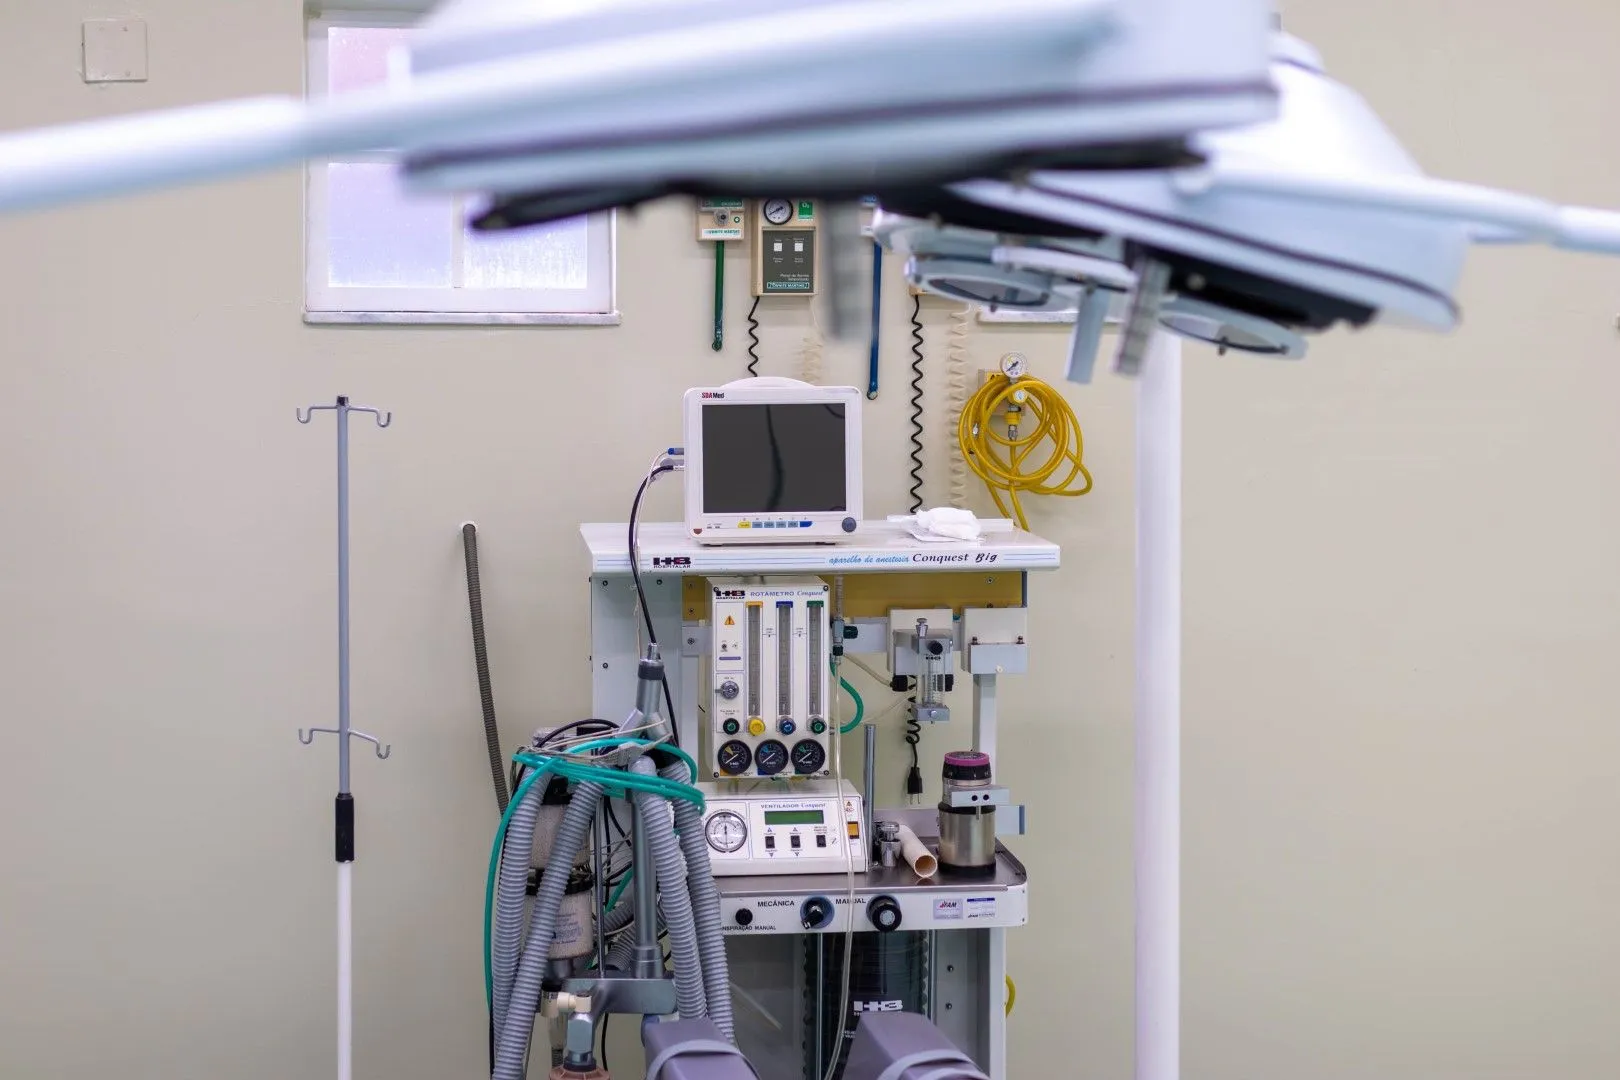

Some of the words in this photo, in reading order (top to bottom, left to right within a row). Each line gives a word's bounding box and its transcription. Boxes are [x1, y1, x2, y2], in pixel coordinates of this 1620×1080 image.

[829, 555, 862, 565] aparelho
[864, 555, 874, 563] de
[912, 553, 969, 564] Conquest
[975, 552, 998, 563] Big
[797, 589, 824, 597] Conquest
